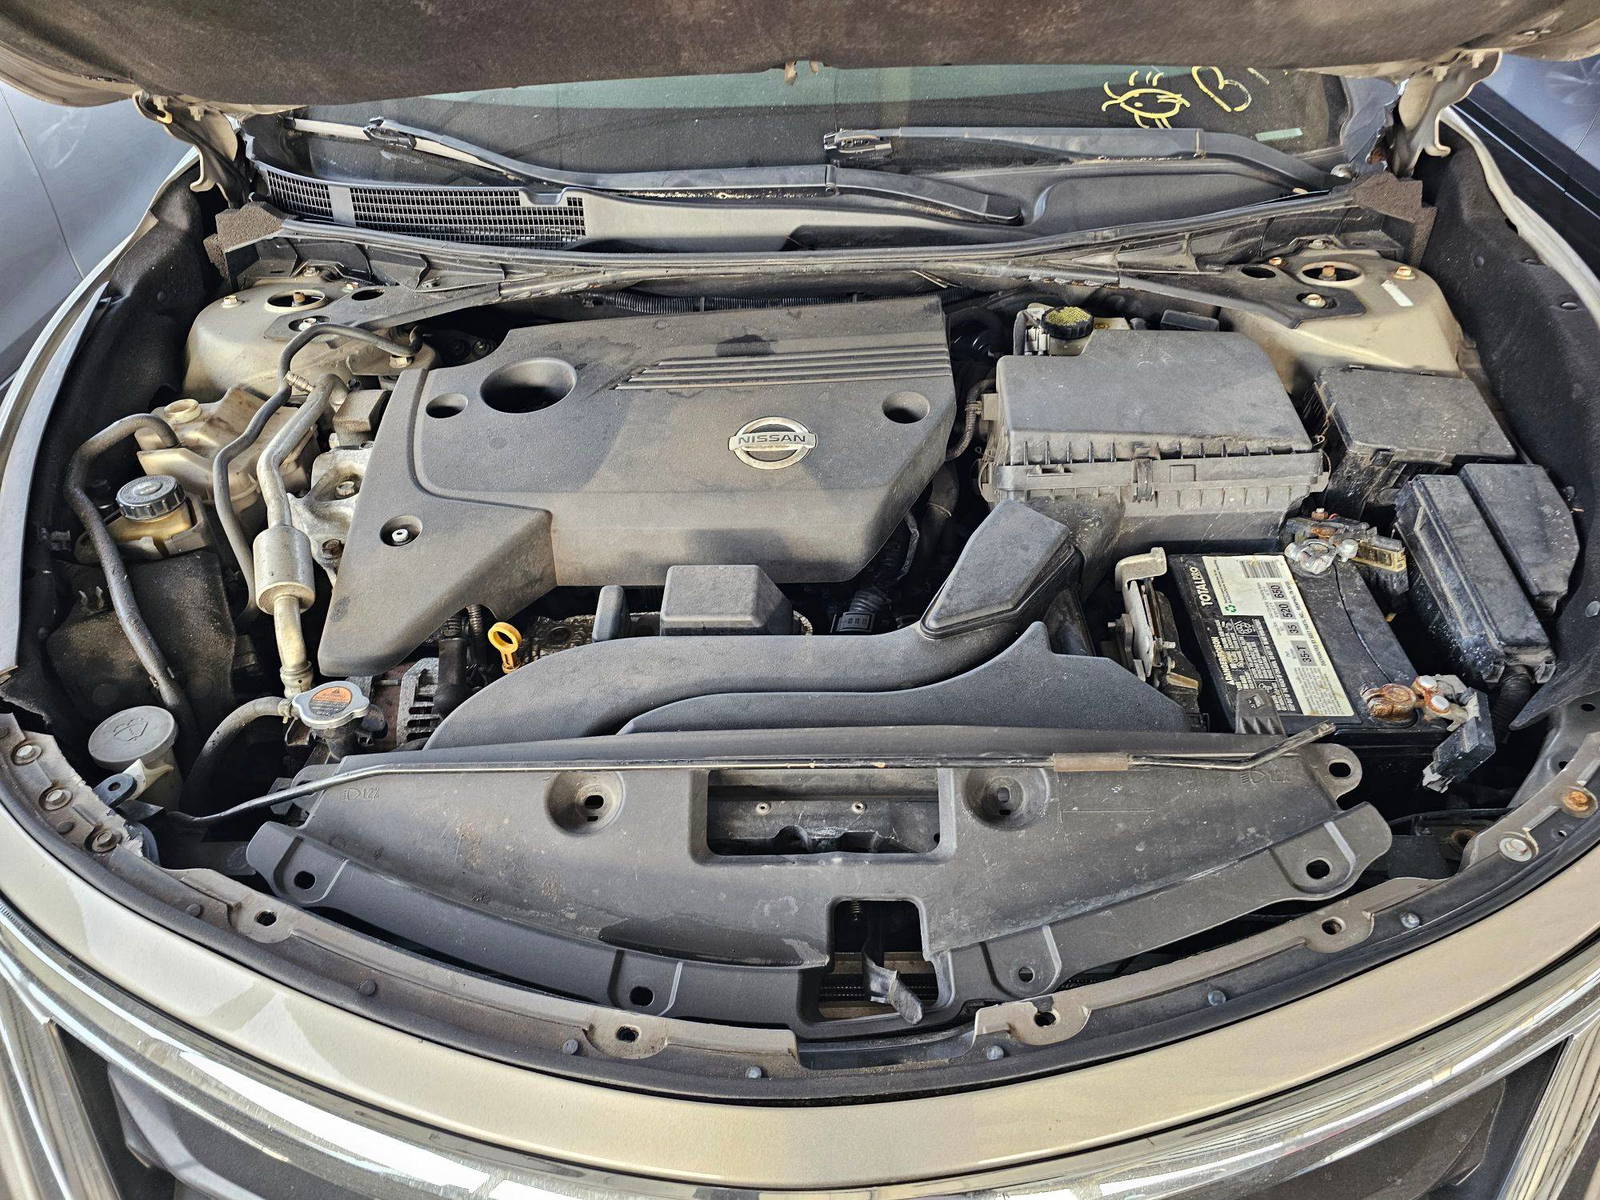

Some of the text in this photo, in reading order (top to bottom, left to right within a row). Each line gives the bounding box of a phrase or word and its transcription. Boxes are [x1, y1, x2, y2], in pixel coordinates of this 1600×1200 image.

[738, 434, 806, 445] NISSAN
[1270, 584, 1285, 600] 650
[1280, 603, 1293, 619] 520
[1288, 623, 1299, 634] 35
[1298, 646, 1312, 663] 35-T
